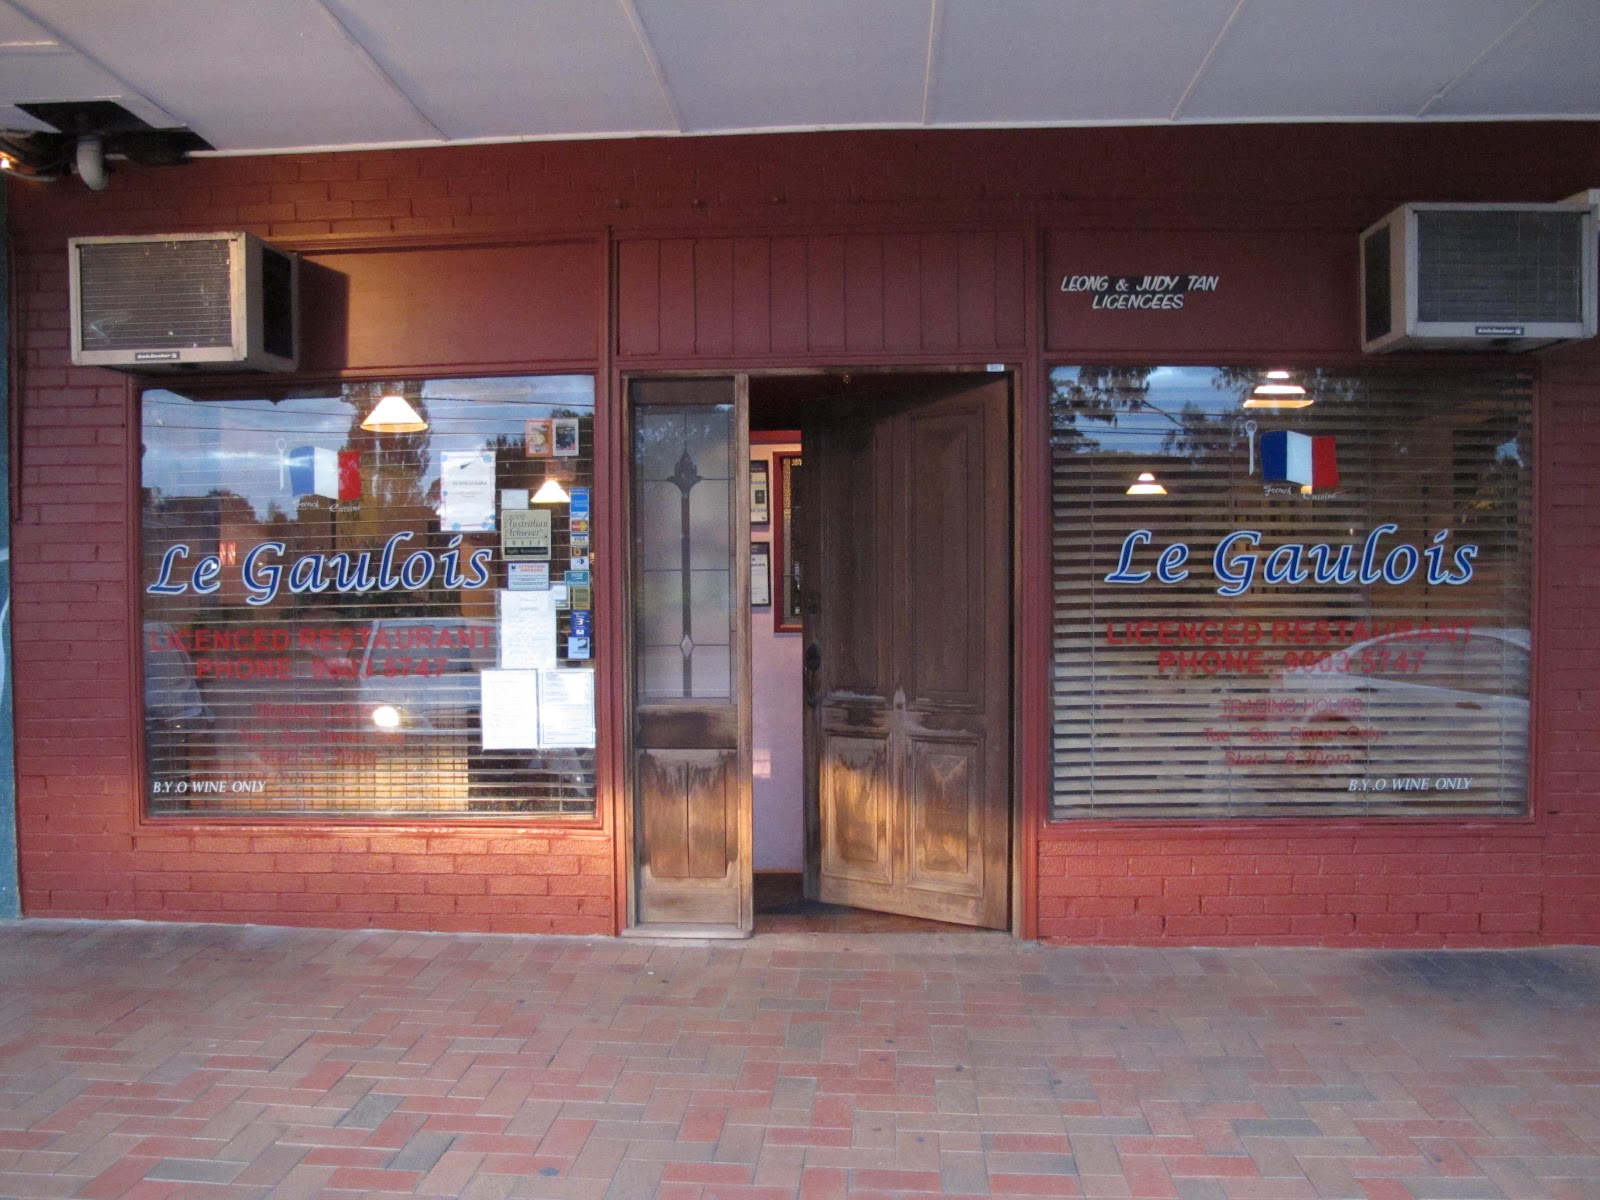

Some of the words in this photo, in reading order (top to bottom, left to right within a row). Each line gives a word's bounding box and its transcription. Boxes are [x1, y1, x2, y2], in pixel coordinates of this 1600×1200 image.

[1061, 275, 1109, 291] LEONG
[1115, 279, 1129, 291] &
[1135, 275, 1179, 291] JUDY
[1187, 275, 1219, 291] TAN
[1092, 294, 1184, 310] LICENCEES
[147, 544, 221, 596] Le
[242, 531, 493, 606] Gaulois
[1104, 530, 1189, 584] Le
[1211, 523, 1479, 597] Gaulois
[150, 629, 289, 652] LICENCED
[299, 626, 492, 650] RESTAURANT
[1107, 621, 1262, 644] LICENCED
[1270, 620, 1474, 644] RESTAURANT
[384, 656, 447, 679] 5747
[1158, 650, 1273, 673] PHONE:
[1361, 650, 1426, 673] 5747
[1221, 698, 1296, 713] TRADING
[1303, 698, 1364, 713] HOURS
[192, 780, 228, 793] WINE
[232, 780, 267, 793] ONLY
[1392, 778, 1430, 791] WINE
[1435, 777, 1473, 790] ONLY
